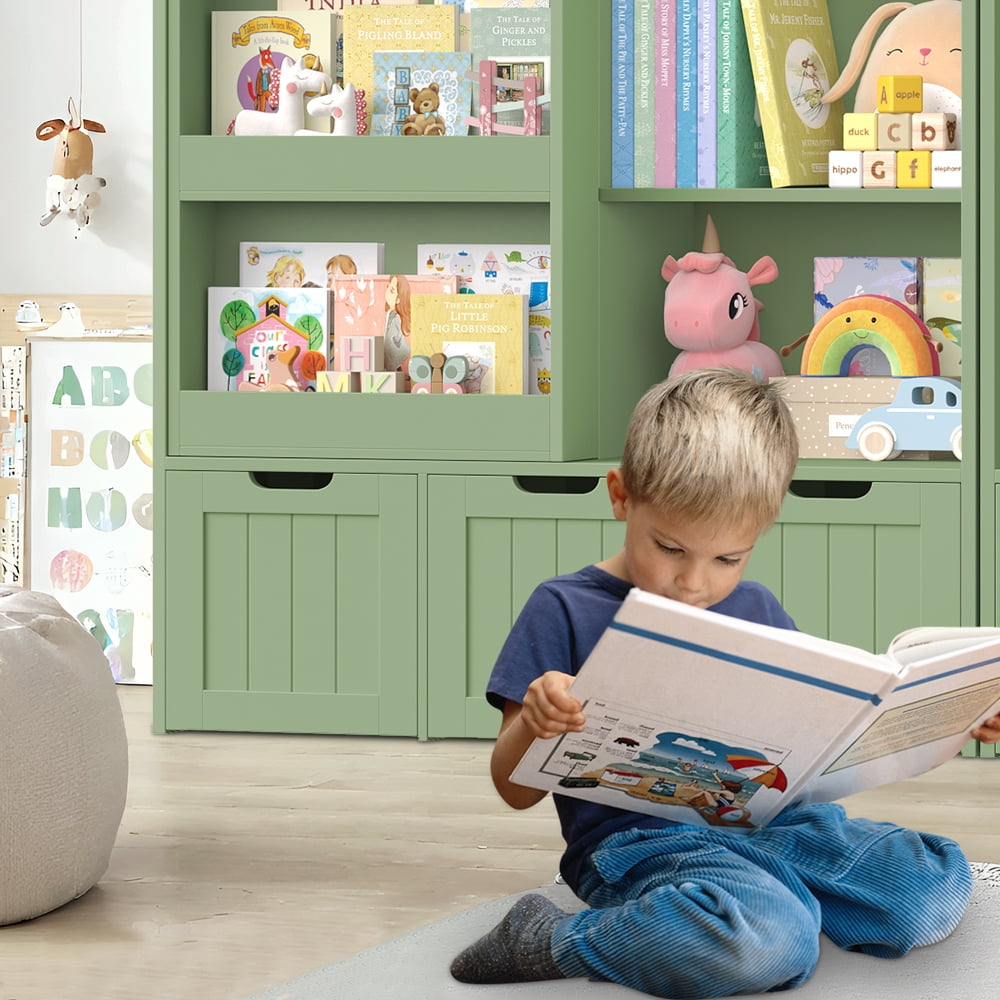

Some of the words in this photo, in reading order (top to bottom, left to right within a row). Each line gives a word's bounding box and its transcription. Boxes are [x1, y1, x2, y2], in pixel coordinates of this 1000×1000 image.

[618, 3, 627, 21] TALE
[357, 30, 402, 40] PIGLING
[405, 30, 442, 40] BLAND
[492, 26, 526, 35] GINGER
[618, 23, 627, 33] OF
[502, 38, 537, 46] PICKLES
[618, 34, 627, 49] THE
[618, 51, 627, 62] PIE
[618, 63, 627, 78] AND
[618, 80, 627, 95] THE
[880, 86, 887, 104] A
[895, 90, 920, 99] apple
[618, 96, 627, 137] PATTY-PAN
[848, 128, 870, 136] duck
[921, 121, 936, 142] b
[832, 165, 858, 175] hippo
[871, 161, 885, 180] G
[909, 158, 918, 179] f
[451, 312, 488, 321] LITTLE
[431, 324, 450, 333] PIG
[453, 324, 508, 333] ROBINSON
[344, 338, 371, 370] H
[316, 373, 349, 392] M
[366, 373, 390, 393] K
[836, 422, 854, 430] Penc
